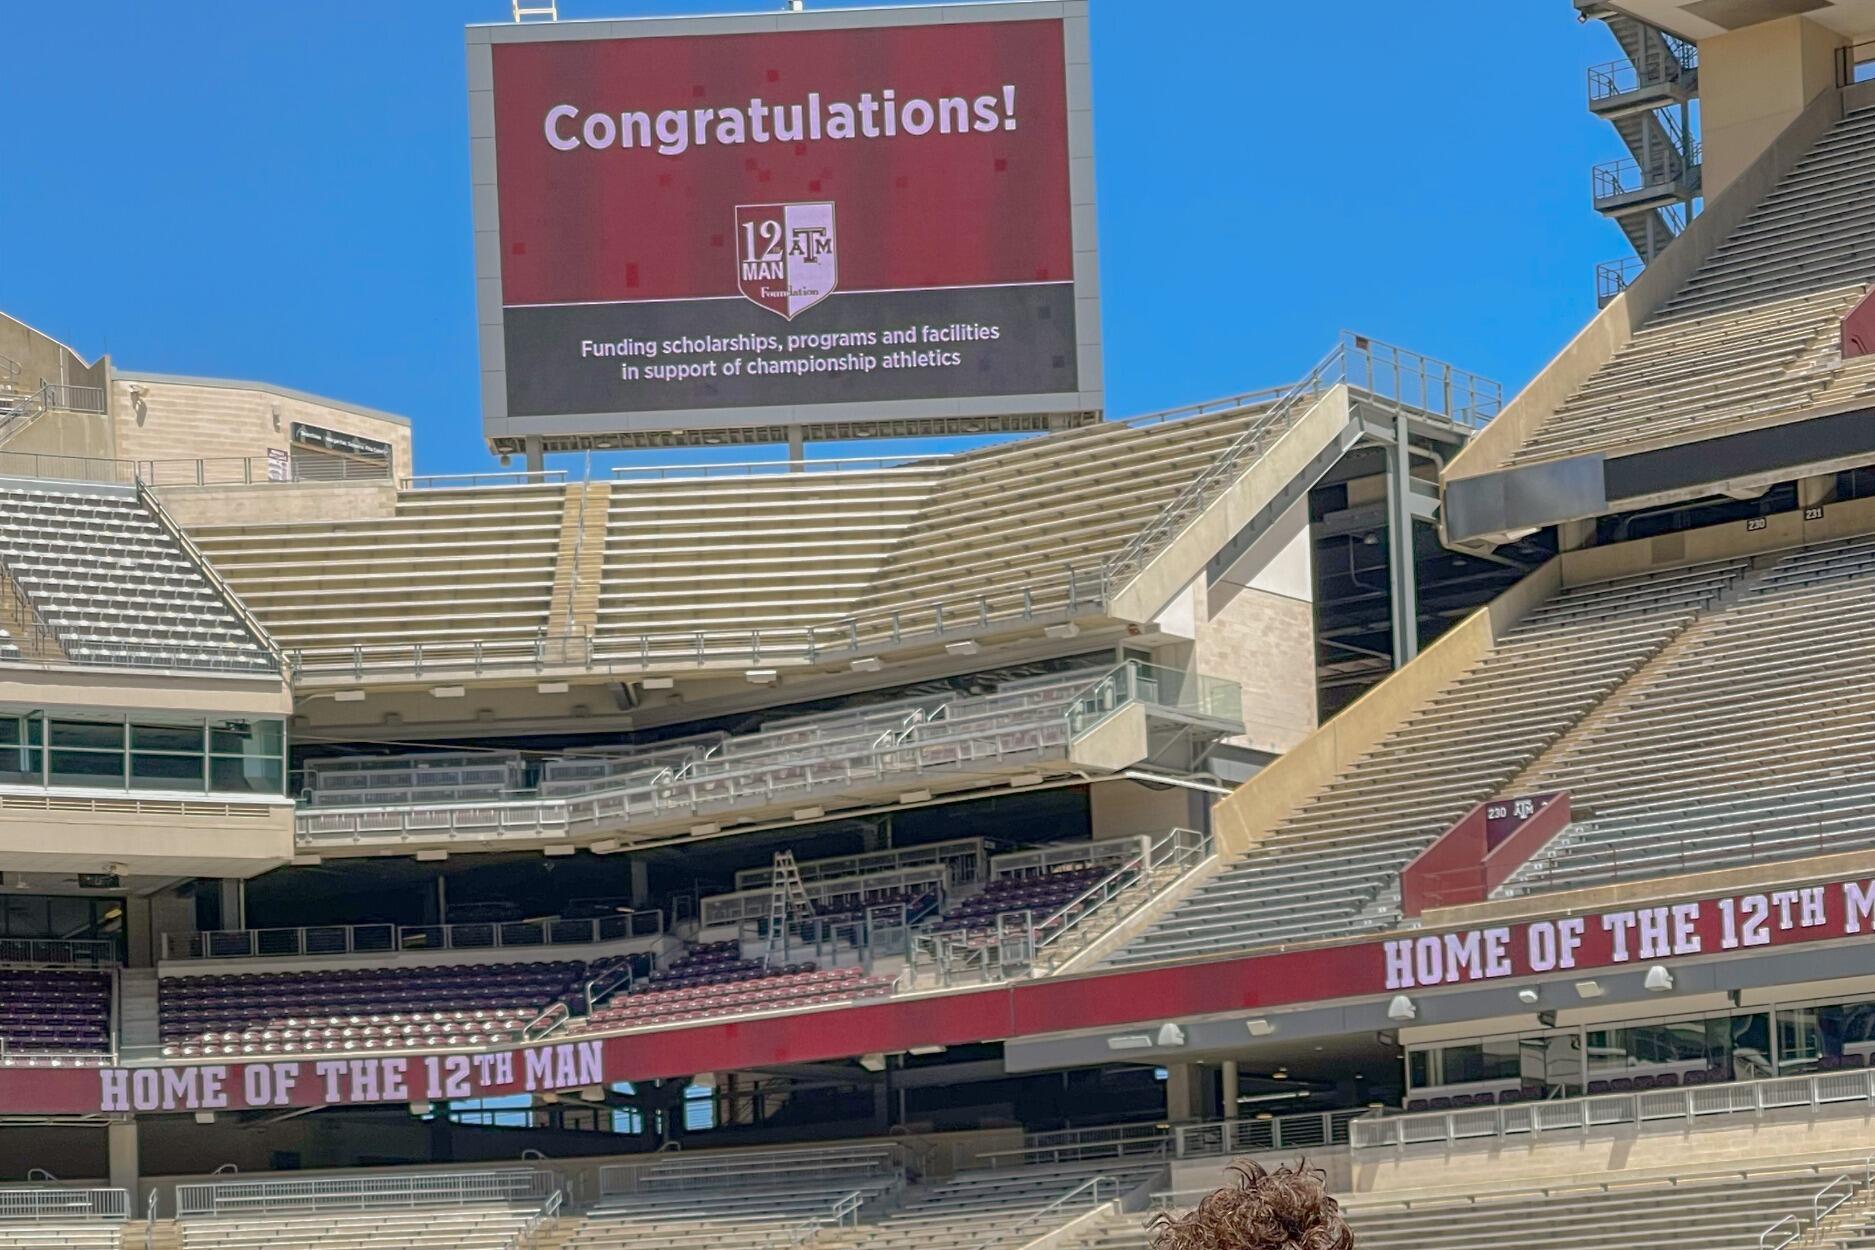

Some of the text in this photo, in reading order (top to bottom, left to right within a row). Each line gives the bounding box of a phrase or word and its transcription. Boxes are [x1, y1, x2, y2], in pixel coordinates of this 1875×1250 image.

[543, 85, 1018, 155] Congratulations!
[743, 261, 784, 281] MAN
[761, 285, 819, 298] Foundation
[581, 323, 1000, 357] Funding scholarships, programs and facilities
[621, 349, 961, 381] in support of championship athletics
[1748, 519, 1766, 530] 230
[1805, 508, 1822, 519] 231
[1488, 806, 1507, 820] 230
[1384, 927, 1512, 990] HOME
[1527, 917, 1585, 973] OF
[1602, 903, 1702, 962] THE
[1718, 886, 1826, 949] 12TH
[100, 1040, 603, 1112] HOME OF THE 12TH MAN
